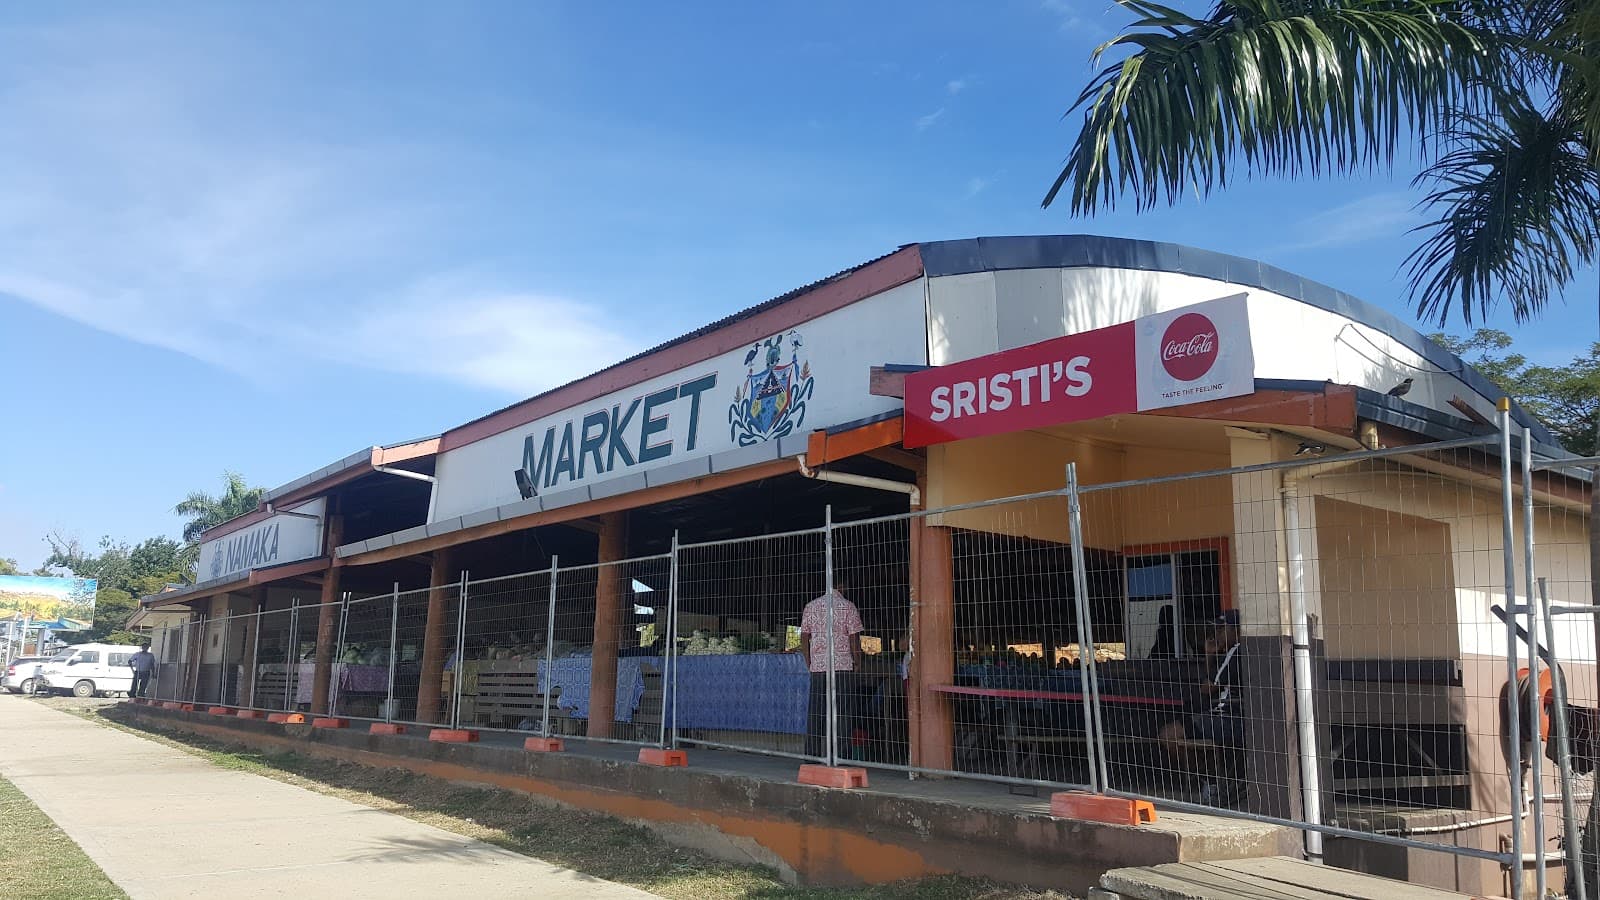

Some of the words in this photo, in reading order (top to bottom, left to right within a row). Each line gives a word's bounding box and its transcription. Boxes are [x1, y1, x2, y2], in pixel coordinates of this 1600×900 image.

[1163, 332, 1214, 360] Coca-Cola
[930, 356, 1093, 422] SRISTI'S
[522, 371, 718, 489] MARKET
[225, 522, 279, 573] NAMAKA
